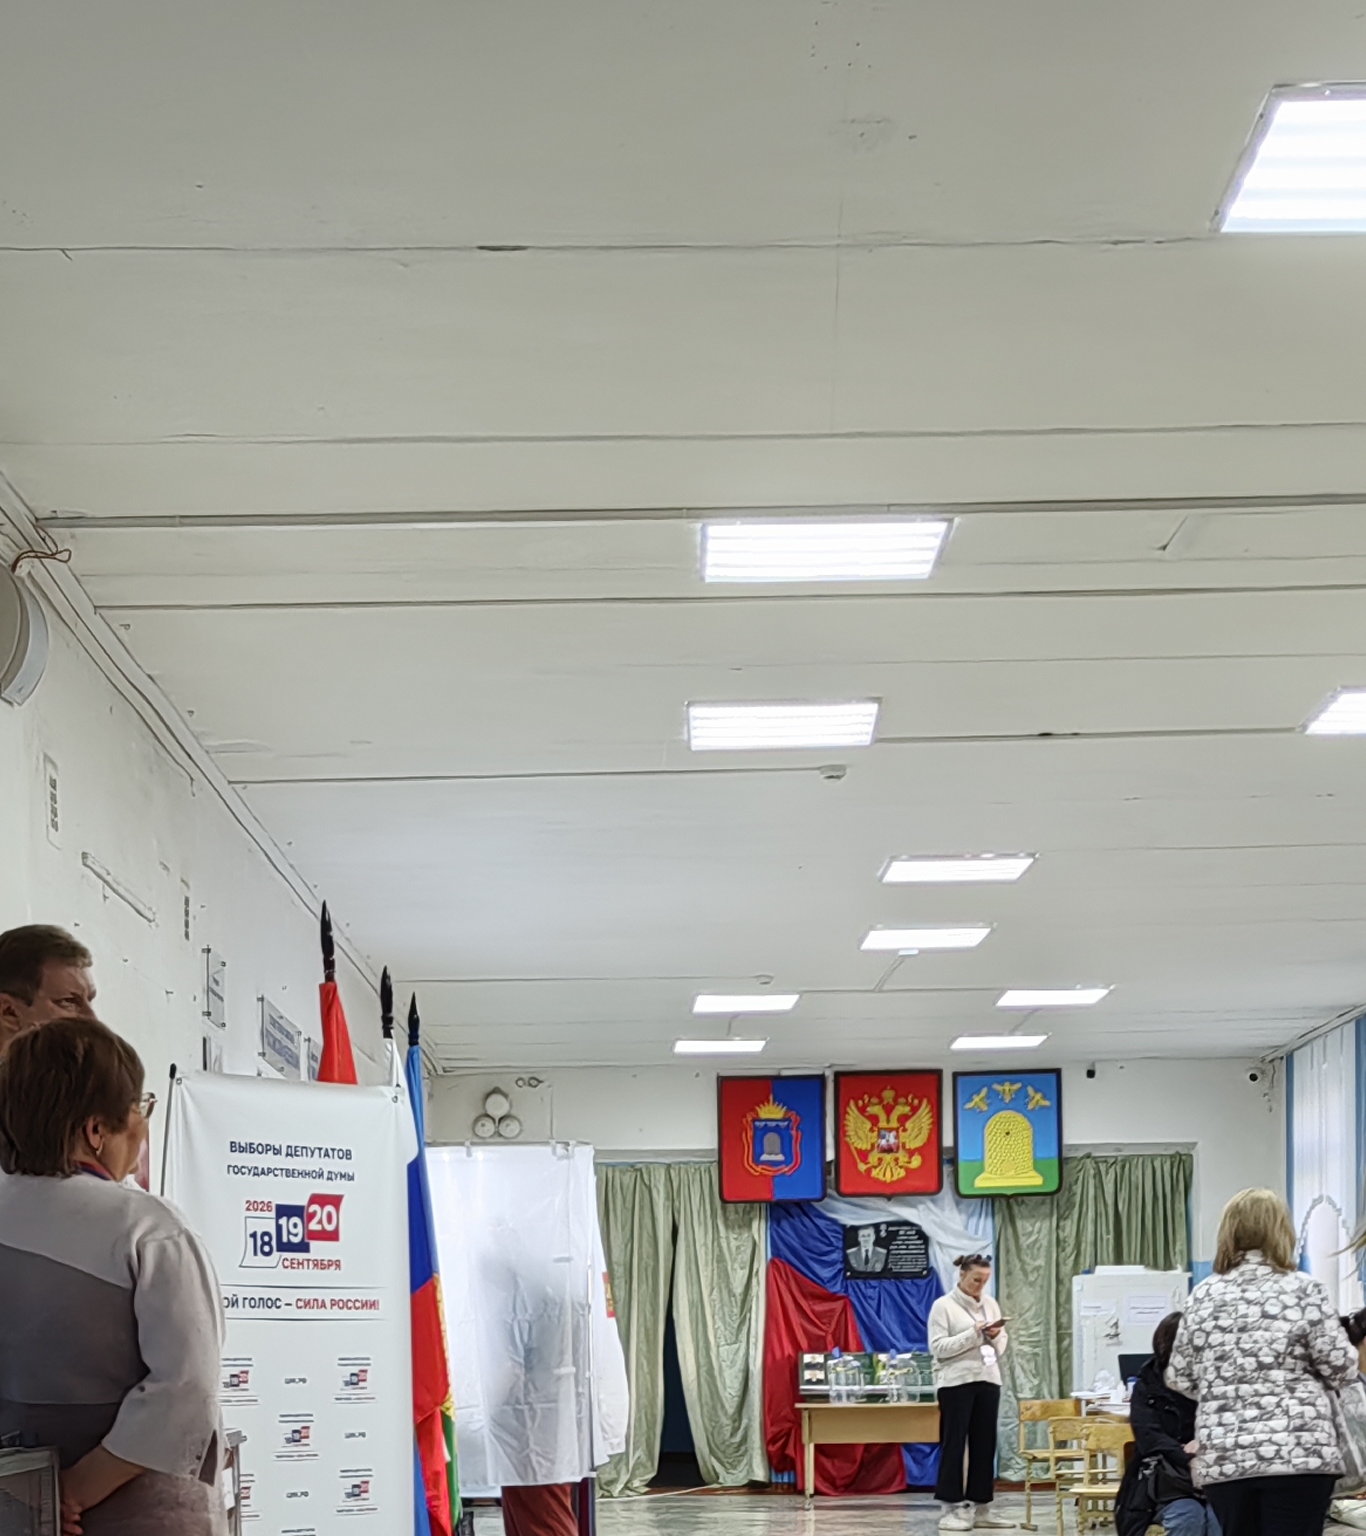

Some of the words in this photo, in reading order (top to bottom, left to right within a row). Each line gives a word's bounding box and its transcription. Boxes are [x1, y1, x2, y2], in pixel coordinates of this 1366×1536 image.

[229, 1141, 282, 1156] ВЫБОРЫ
[285, 1145, 353, 1161] ДЕПУТАТОВ
[227, 1165, 324, 1180] ГОСУДАРСТВЕННОЙ
[326, 1171, 355, 1182] ДУМЫ
[245, 1200, 273, 1213] 2026
[249, 1230, 274, 1257] 18
[278, 1216, 303, 1243] 19
[308, 1204, 337, 1231] 20
[281, 1257, 341, 1271] СЕНТЯБРЯ
[223, 1294, 239, 1309] ОЙ
[242, 1297, 282, 1310] ГОЛОС
[295, 1298, 327, 1310] СИЛА
[330, 1298, 380, 1311] РОССИИ!
